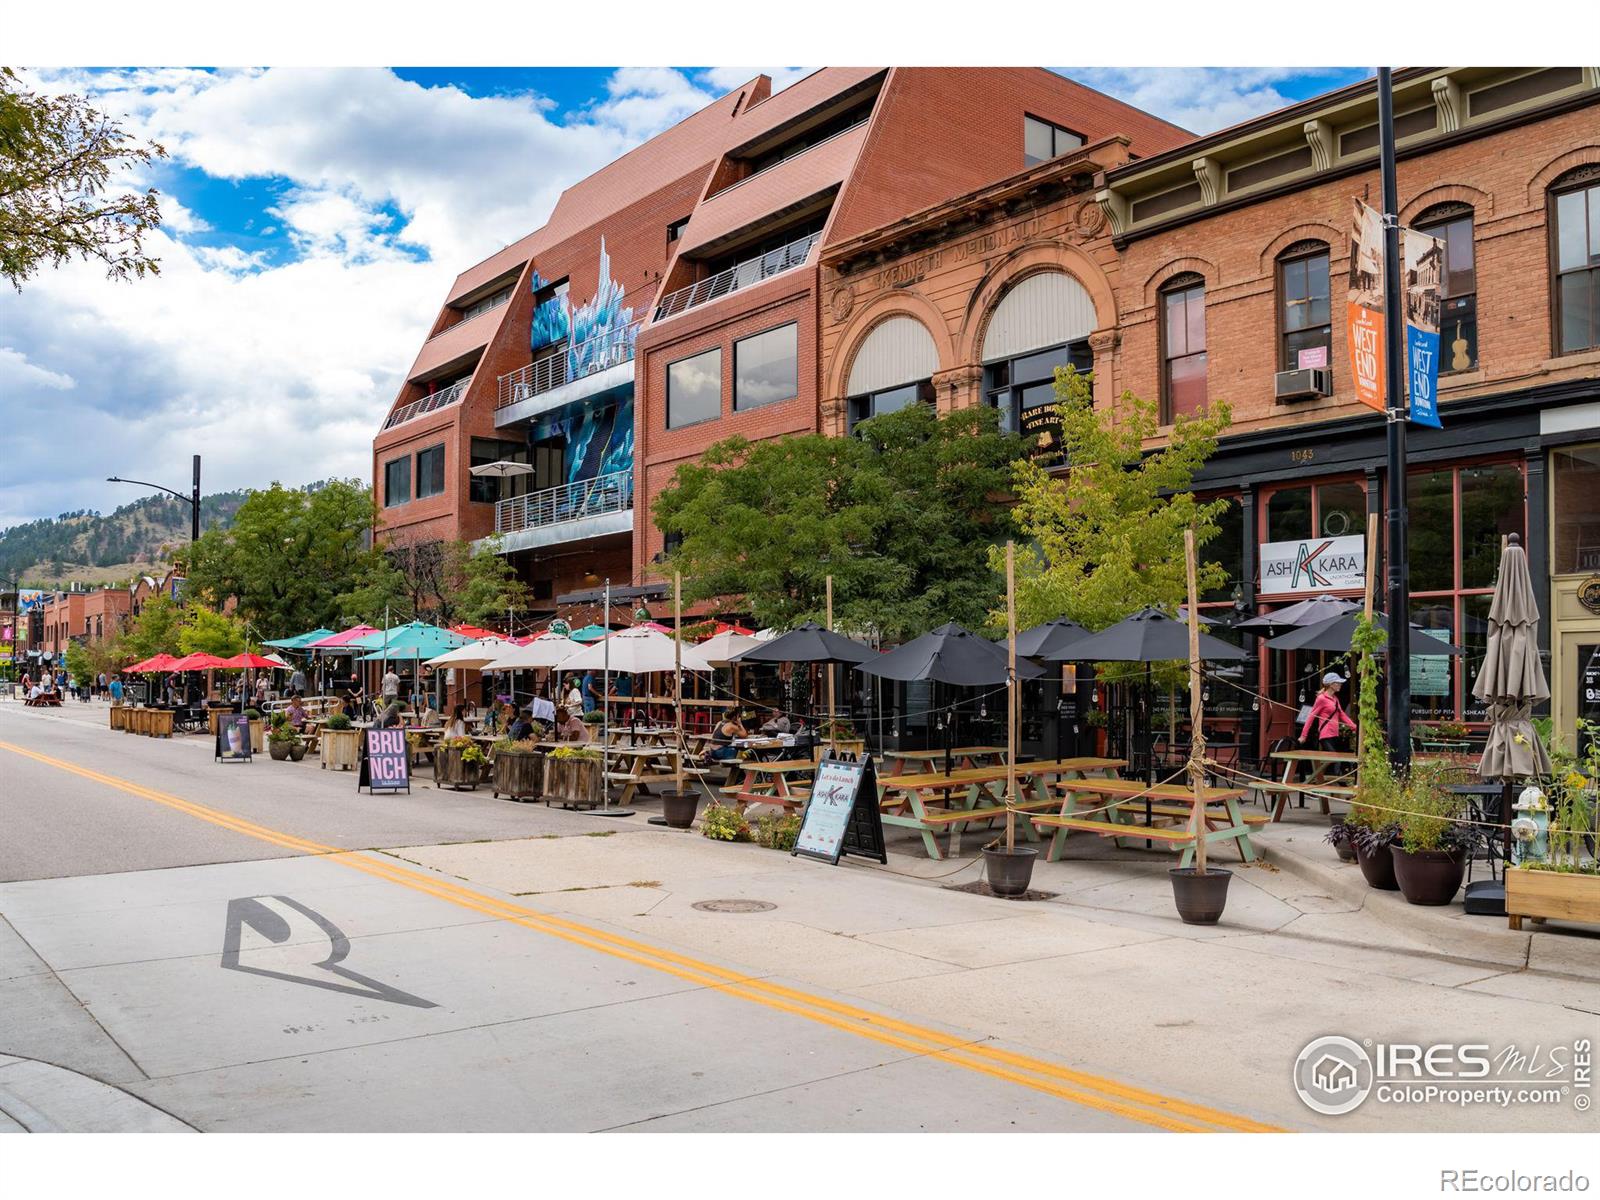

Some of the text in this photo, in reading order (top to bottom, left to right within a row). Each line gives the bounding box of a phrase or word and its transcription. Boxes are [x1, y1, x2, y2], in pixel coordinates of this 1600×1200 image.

[879, 251, 943, 289] KENNETH
[1352, 322, 1377, 355] WEST
[1355, 349, 1377, 380] END
[1412, 345, 1432, 374] WEST
[1413, 368, 1431, 399] END
[1021, 406, 1043, 420] RARE
[1045, 416, 1060, 425] ART
[1319, 556, 1358, 572] KARA
[368, 730, 405, 754] BRU
[370, 756, 407, 780] NCH
